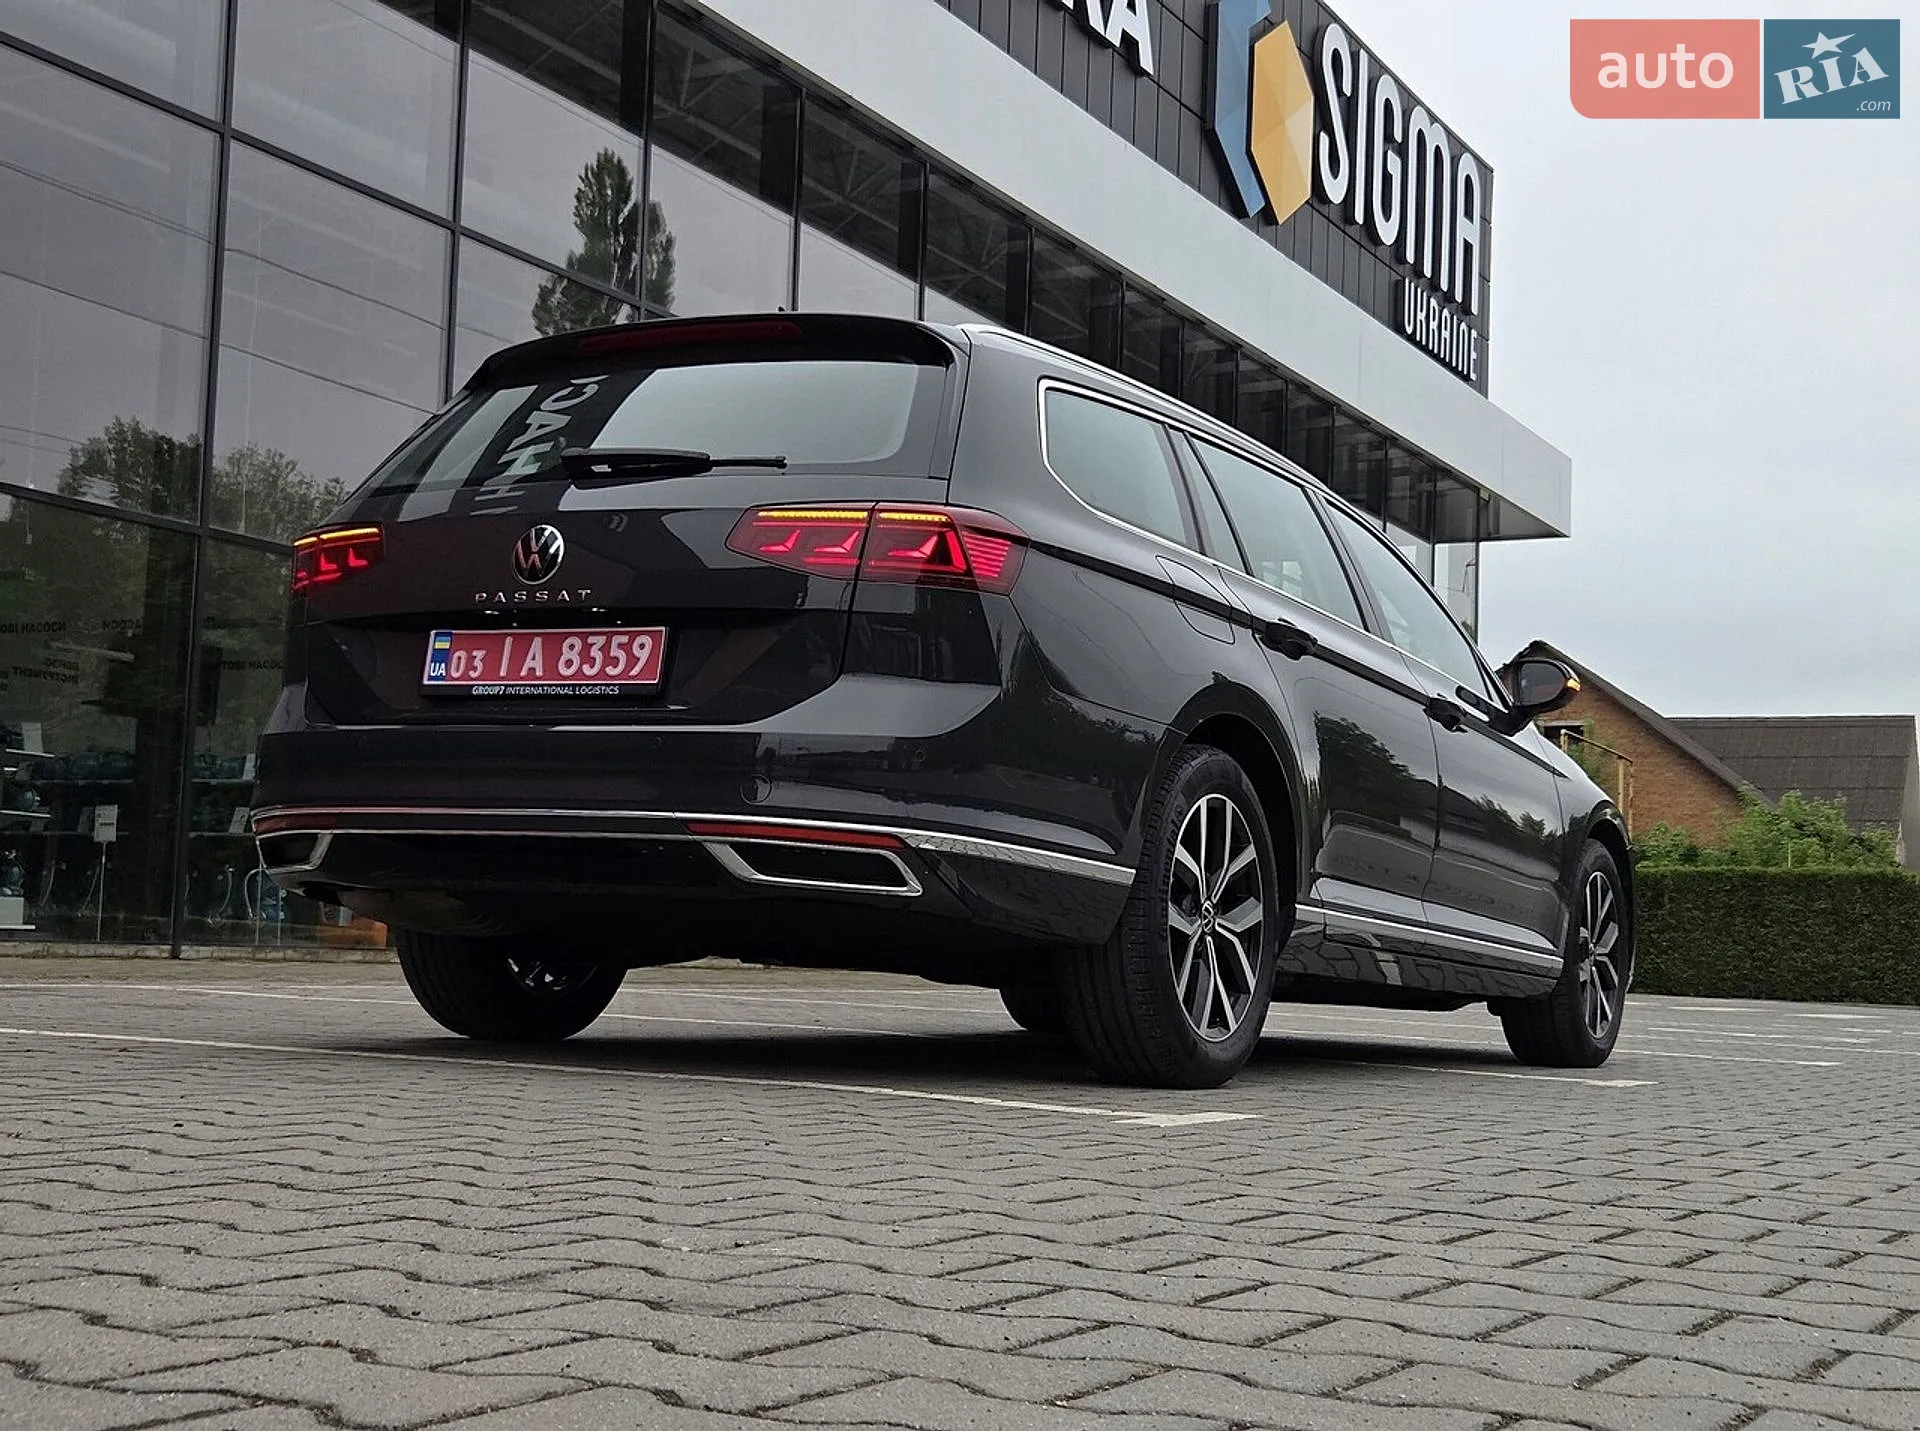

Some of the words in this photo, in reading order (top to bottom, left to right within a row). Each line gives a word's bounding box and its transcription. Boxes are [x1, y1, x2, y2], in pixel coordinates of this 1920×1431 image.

[1319, 23, 1479, 316] SIGMA
[1405, 278, 1477, 381] UKRAINE
[475, 589, 591, 604] PASSAT
[430, 662, 447, 677] UA
[450, 650, 487, 679] 03
[557, 634, 653, 677] 8359
[505, 685, 574, 695] INTERNATIONAL
[576, 685, 620, 695] LOGISTICS
